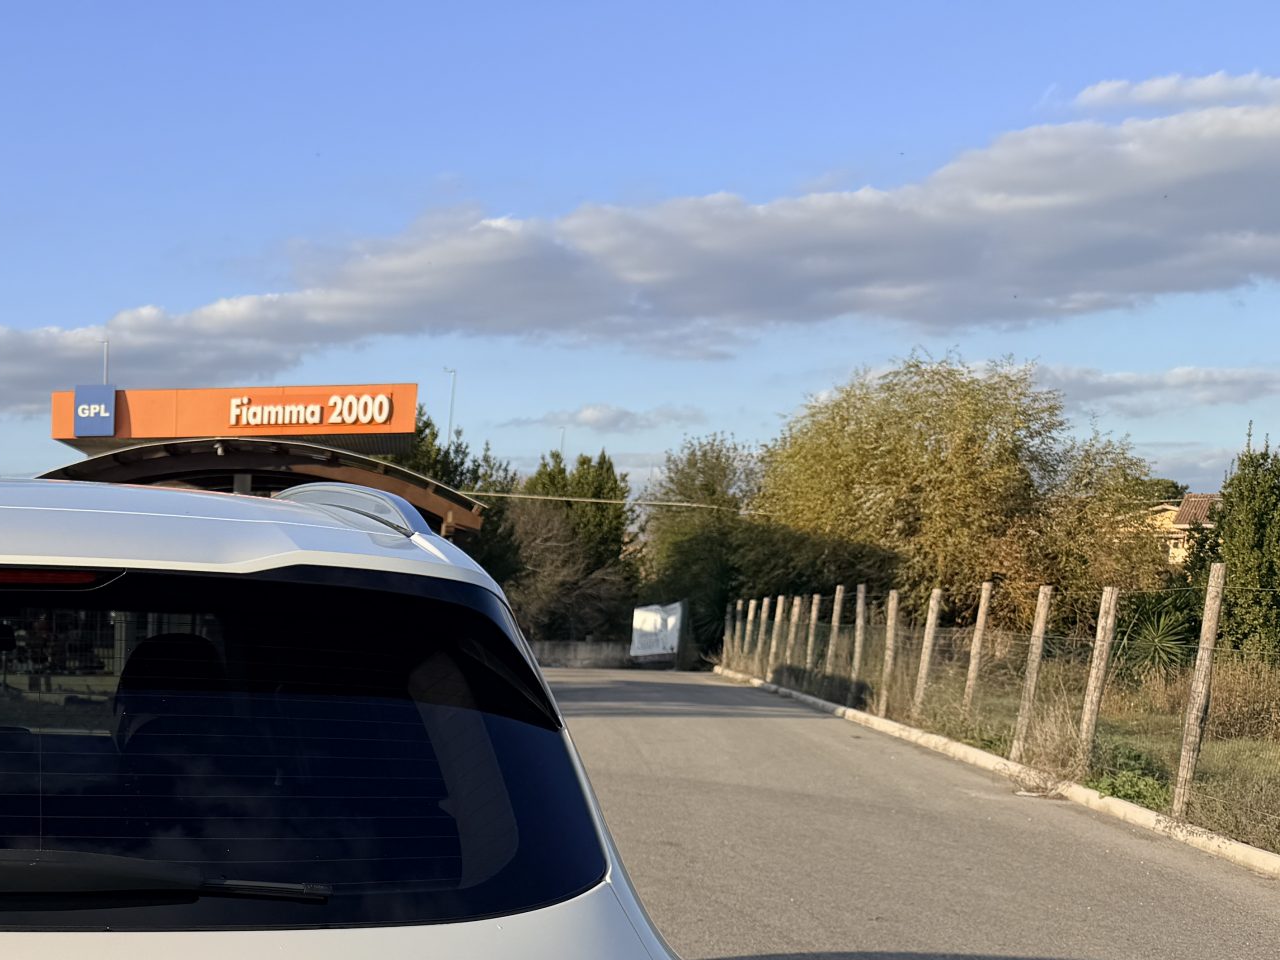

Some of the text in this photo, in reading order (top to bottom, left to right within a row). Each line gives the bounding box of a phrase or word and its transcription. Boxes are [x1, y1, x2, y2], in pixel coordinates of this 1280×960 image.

[77, 403, 111, 418] GPL
[229, 393, 391, 426] Fiamma 2000
